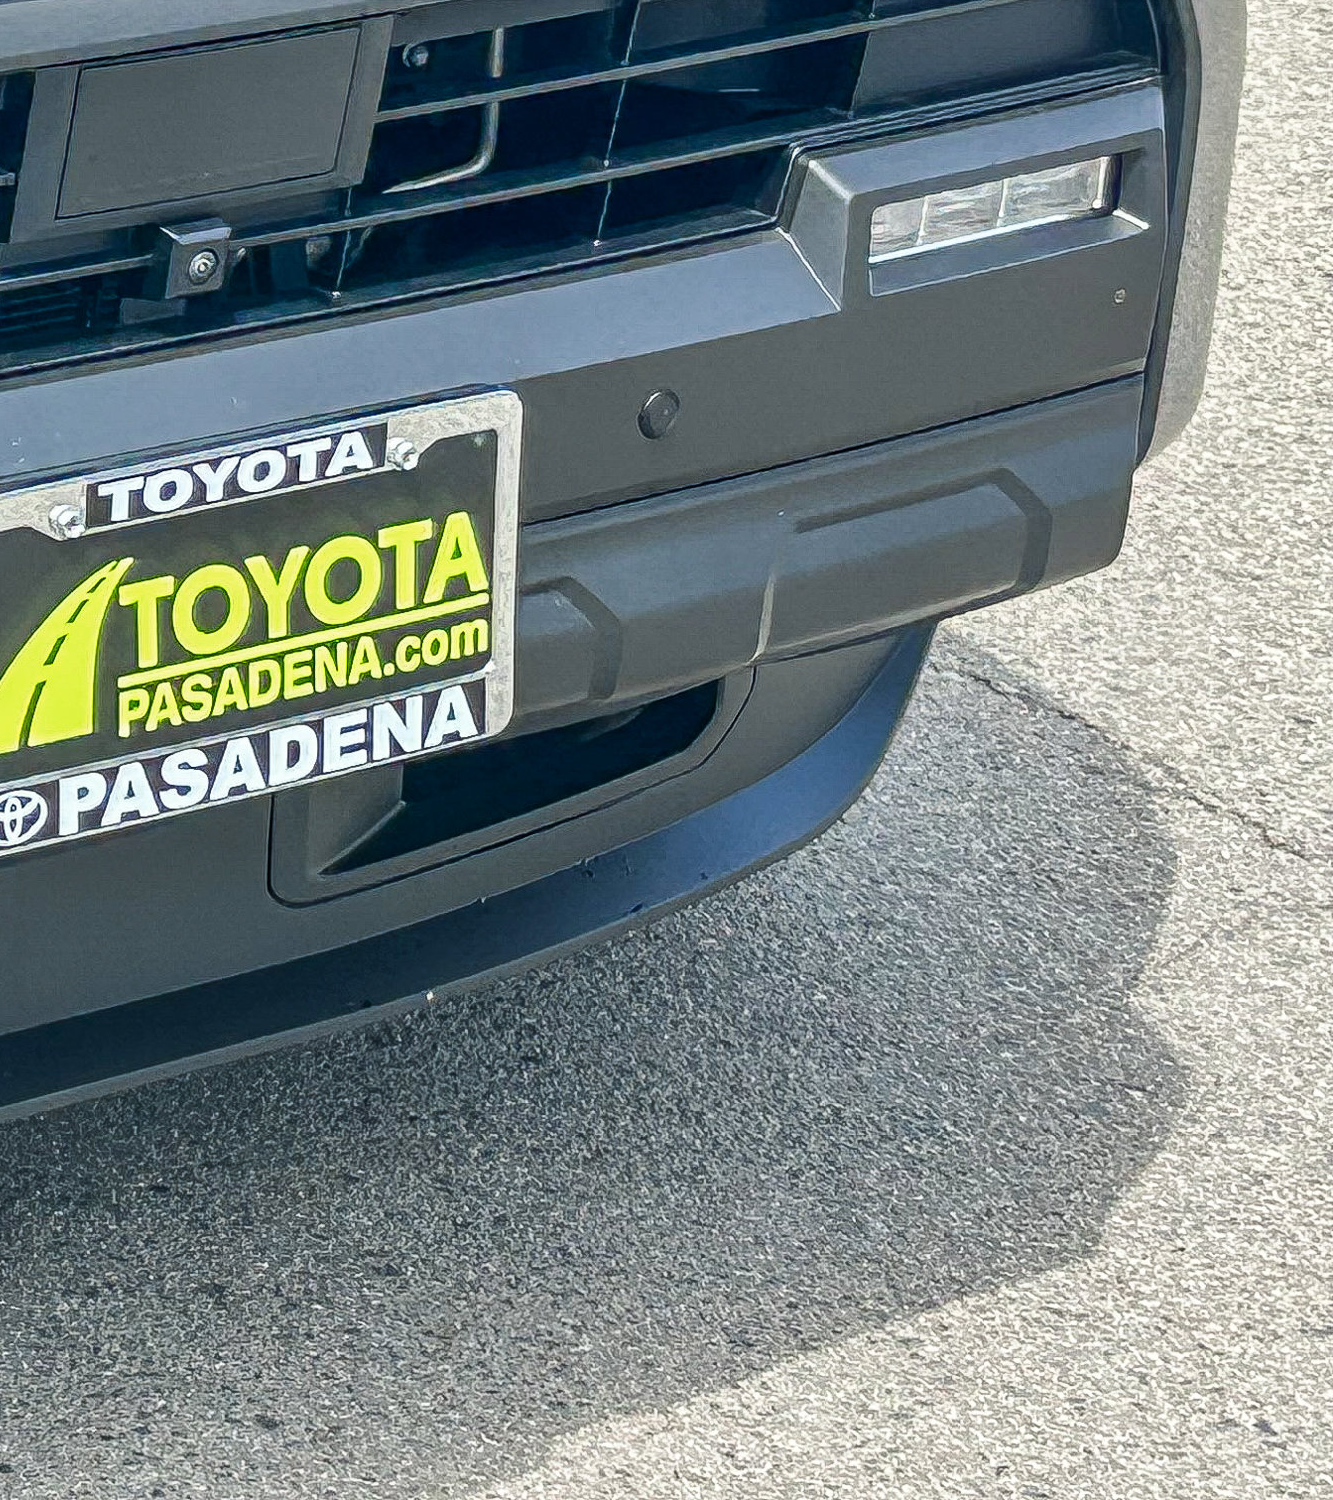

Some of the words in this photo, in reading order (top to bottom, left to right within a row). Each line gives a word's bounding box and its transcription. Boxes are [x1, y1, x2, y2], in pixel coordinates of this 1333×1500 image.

[97, 431, 374, 522] TOYOTA
[118, 513, 489, 669] TOYOTA
[118, 618, 489, 738] PASADENA.com
[58, 685, 480, 837] PASADENA
